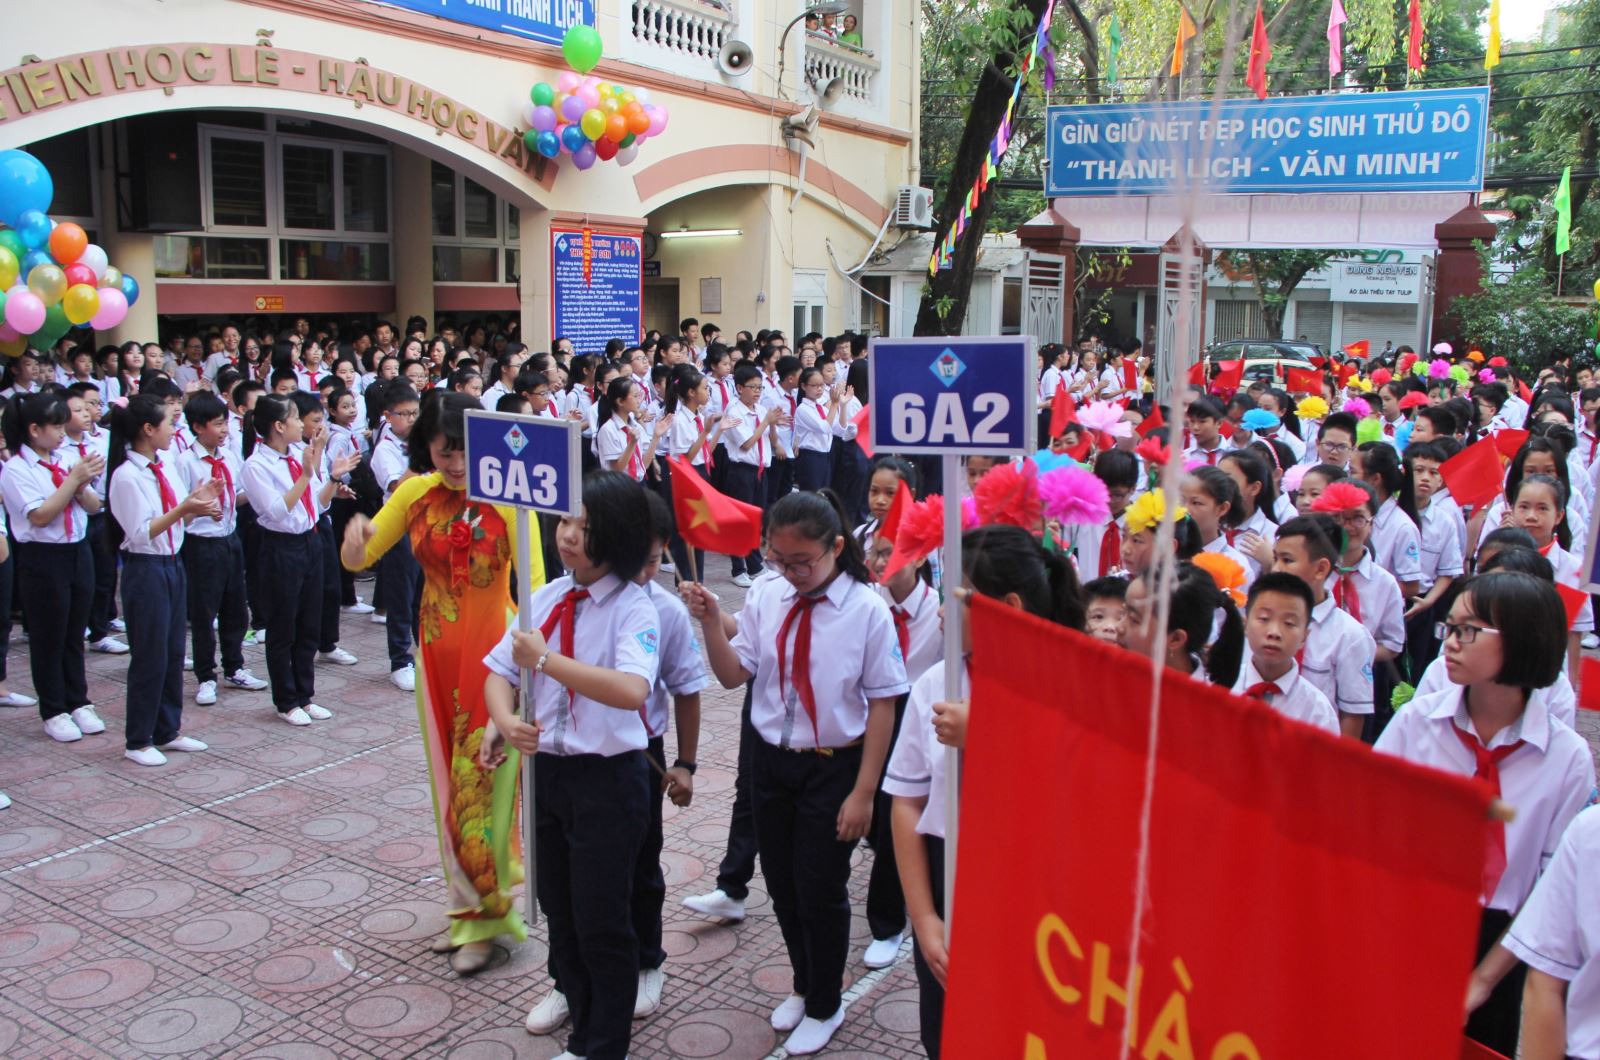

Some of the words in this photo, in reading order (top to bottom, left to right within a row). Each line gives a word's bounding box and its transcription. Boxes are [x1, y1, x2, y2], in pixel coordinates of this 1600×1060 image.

[106, 45, 216, 97] HỌC
[228, 28, 281, 86] LỄ
[319, 56, 403, 109] HẬU
[407, 83, 479, 136] HỌC
[1061, 119, 1099, 145] GÌN
[1104, 117, 1145, 144] GIỮ
[1150, 115, 1194, 142] NÉT
[1251, 116, 1301, 146] HỌC
[1308, 114, 1366, 138] SINH
[1373, 102, 1425, 136] THỦ
[1431, 103, 1471, 134] ĐÔ
[1187, 157, 1252, 185] LỊCH
[1279, 149, 1346, 178] VĂN
[890, 392, 1010, 444] 6A2
[478, 455, 558, 507] 6A3
